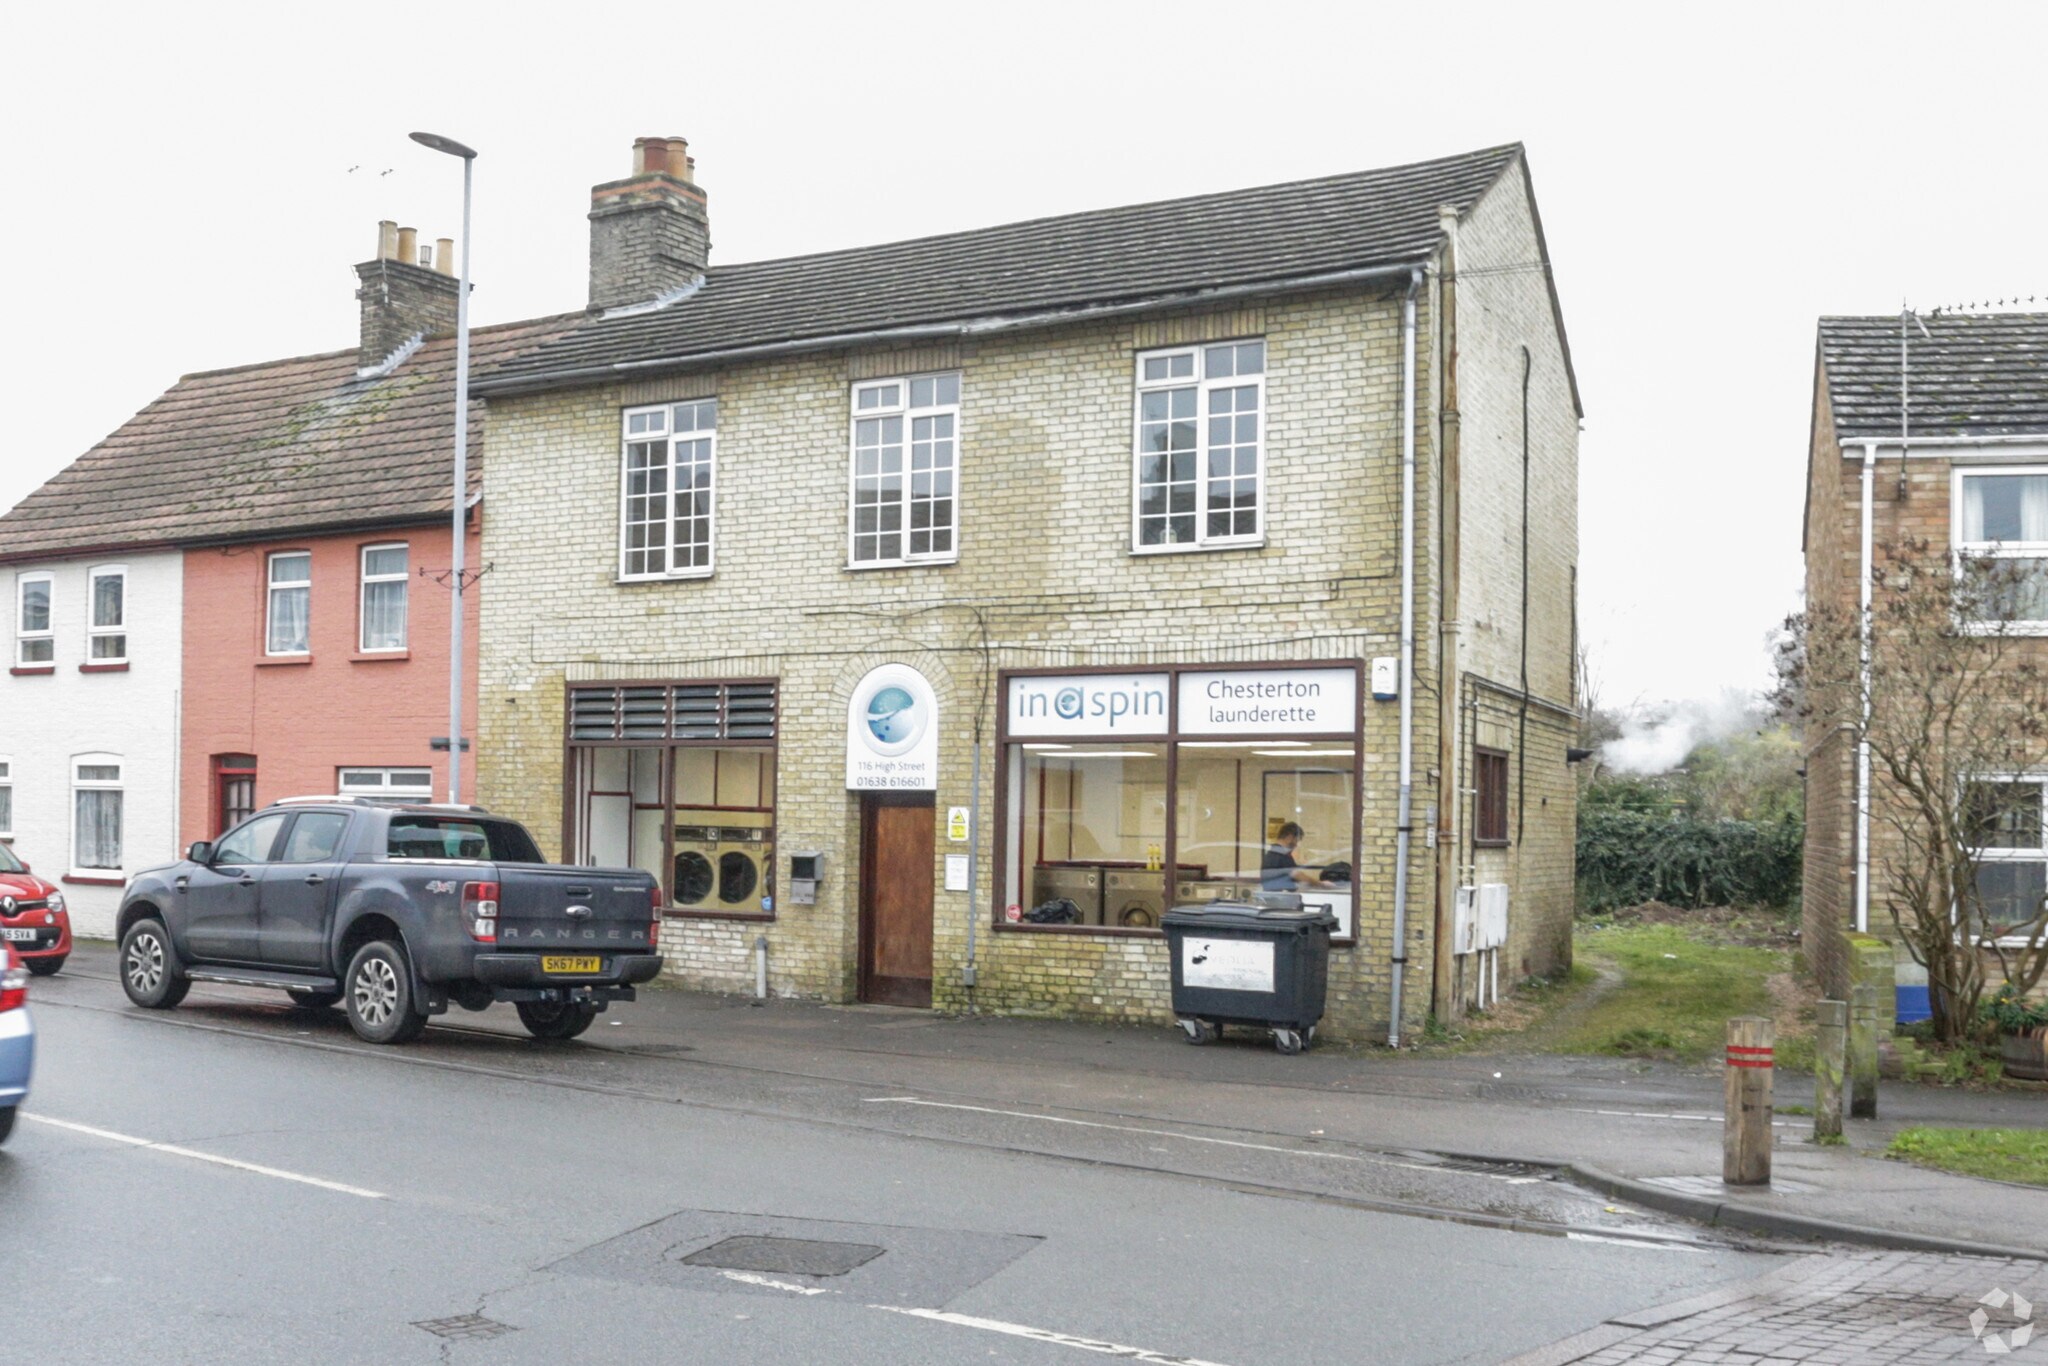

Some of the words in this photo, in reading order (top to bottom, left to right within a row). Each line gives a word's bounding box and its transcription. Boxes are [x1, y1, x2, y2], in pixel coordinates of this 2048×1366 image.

[1207, 679, 1321, 699] Chesterton
[1019, 684, 1047, 717] in
[1090, 681, 1164, 728] spin
[1209, 705, 1316, 723] launderette
[858, 761, 873, 771] 116
[875, 761, 896, 774] High
[898, 761, 926, 771] Street
[856, 777, 887, 787] 01638
[889, 777, 926, 787] 616601
[14, 930, 31, 939] SVA
[503, 928, 645, 940] RANGER
[546, 957, 573, 970] SK67
